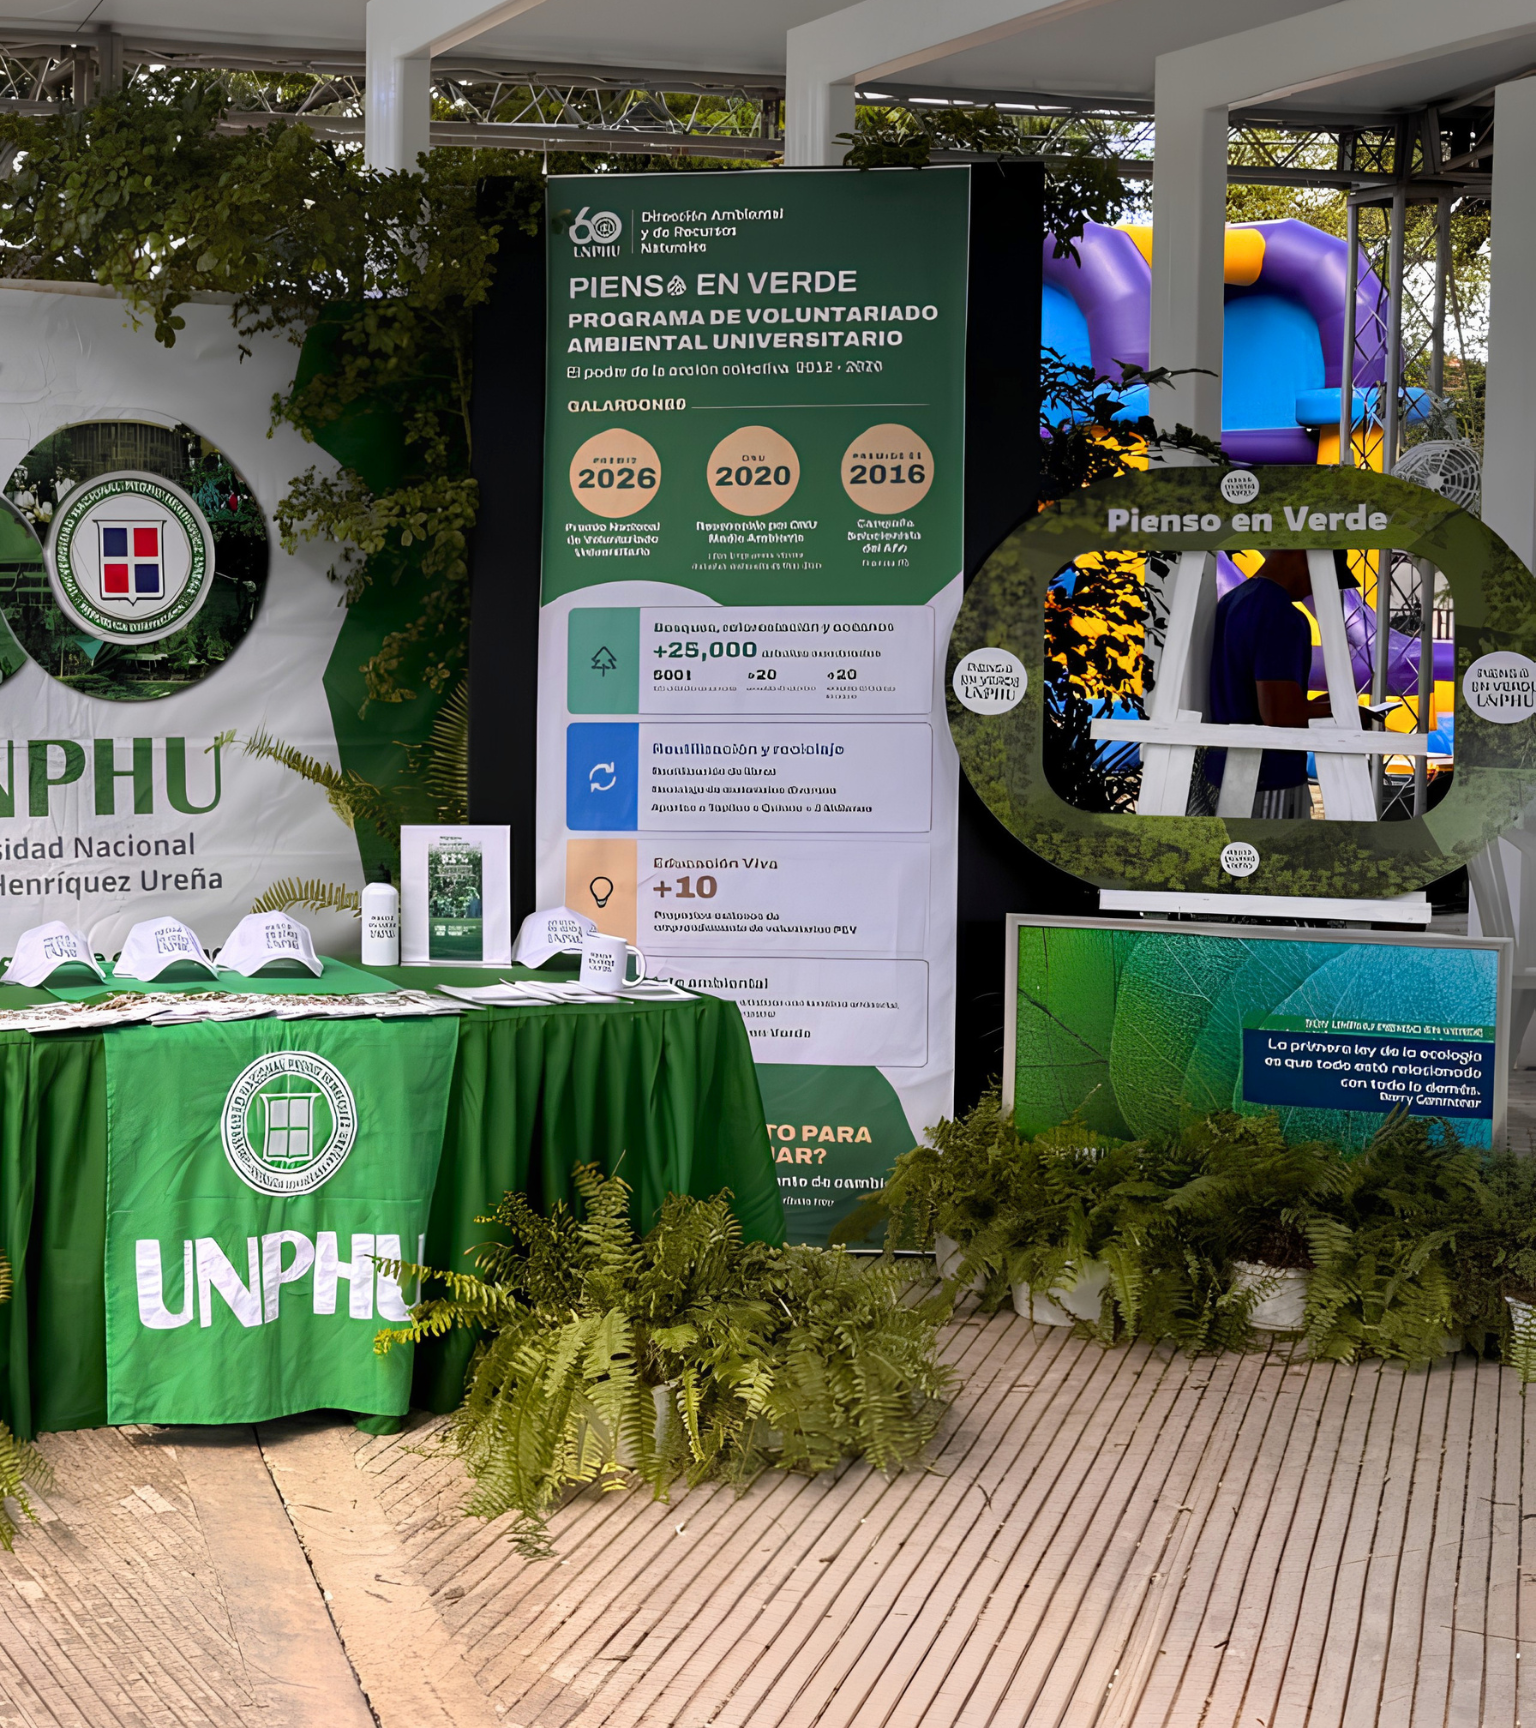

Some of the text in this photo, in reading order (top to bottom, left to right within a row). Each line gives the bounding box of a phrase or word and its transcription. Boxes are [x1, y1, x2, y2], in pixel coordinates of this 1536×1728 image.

[641, 229, 648, 240] y
[697, 272, 739, 295] EN
[747, 270, 858, 294] VERDE
[568, 305, 939, 328] PROGRAMA DE VOLUNTARIADO
[567, 331, 903, 353] AMBIENTAL UNIVERSITARIO
[578, 468, 656, 489] 2026
[715, 466, 791, 486] 2020
[849, 464, 925, 485] 2016
[1108, 505, 1387, 533] Pienso en Verde
[653, 641, 757, 661] +25,000
[74, 832, 196, 860] Nacional
[141, 868, 223, 892] Ureña
[653, 875, 718, 898] +10
[802, 1125, 872, 1143] PARA
[135, 1230, 425, 1330] UNPHU
